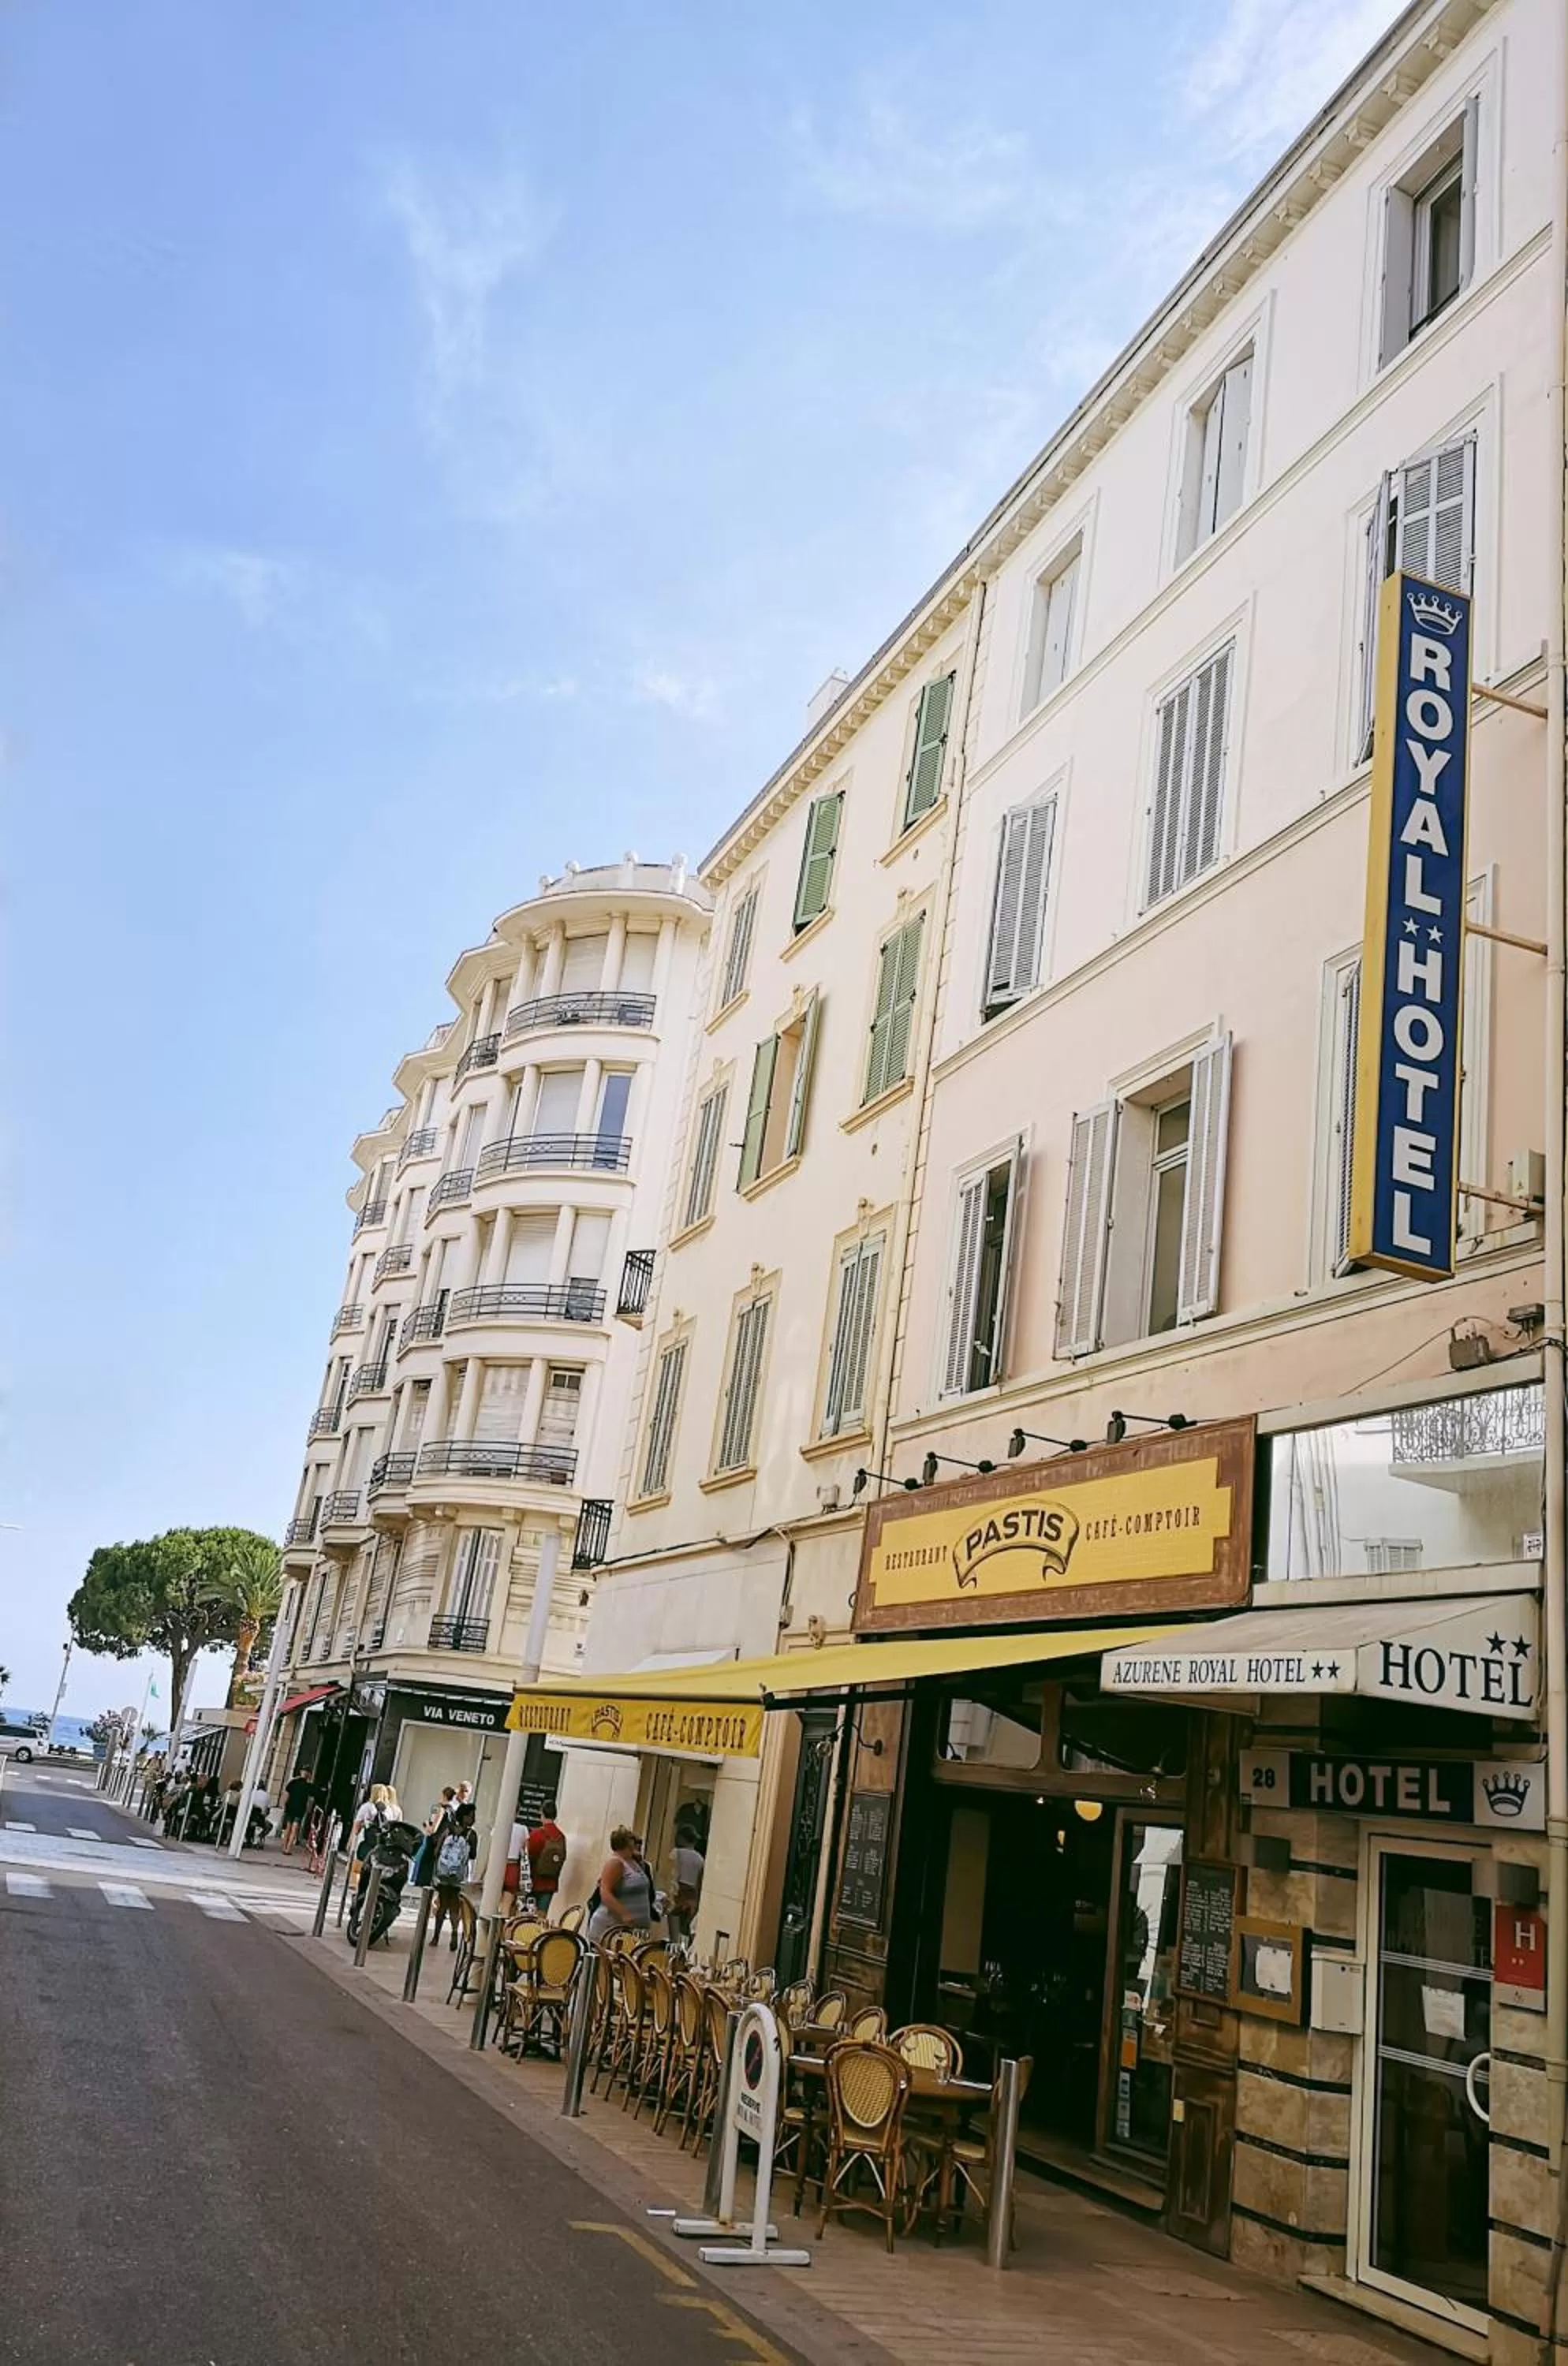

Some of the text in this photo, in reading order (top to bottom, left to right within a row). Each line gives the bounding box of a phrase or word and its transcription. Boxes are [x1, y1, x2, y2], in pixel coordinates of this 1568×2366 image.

[1391, 632, 1454, 1256] ROYAL HOTEL
[885, 1506, 1200, 1571] RESTAURANT PASTIS CAFÉ-COMPTOIR
[1112, 1657, 1306, 1684] AZURENE ROYAL HOTEL
[1379, 1640, 1534, 1708] HOTEL
[424, 1705, 495, 1726] VIA VENETO
[1252, 1767, 1276, 1789] 28
[1309, 1762, 1451, 1814] HOTEL
[1515, 1920, 1536, 1951] H
